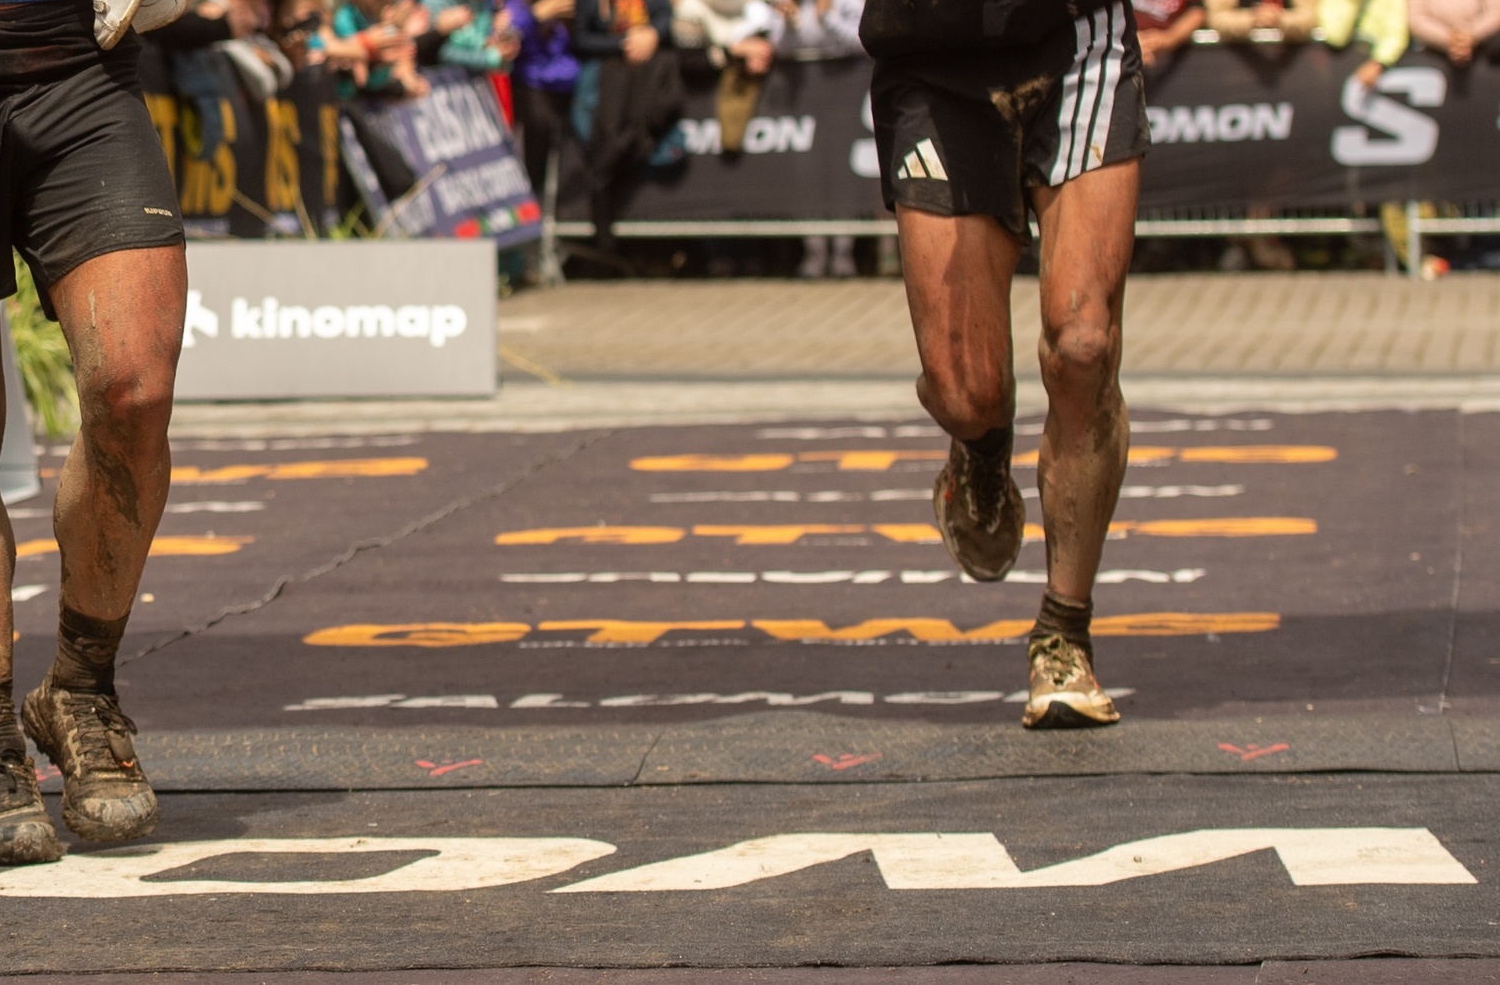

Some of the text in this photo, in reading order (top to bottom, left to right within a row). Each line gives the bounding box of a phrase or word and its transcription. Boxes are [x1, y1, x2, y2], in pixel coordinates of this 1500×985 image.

[231, 296, 468, 347] kinomap
[302, 612, 1280, 648] GTWS
[283, 687, 1136, 712] SALOMO
